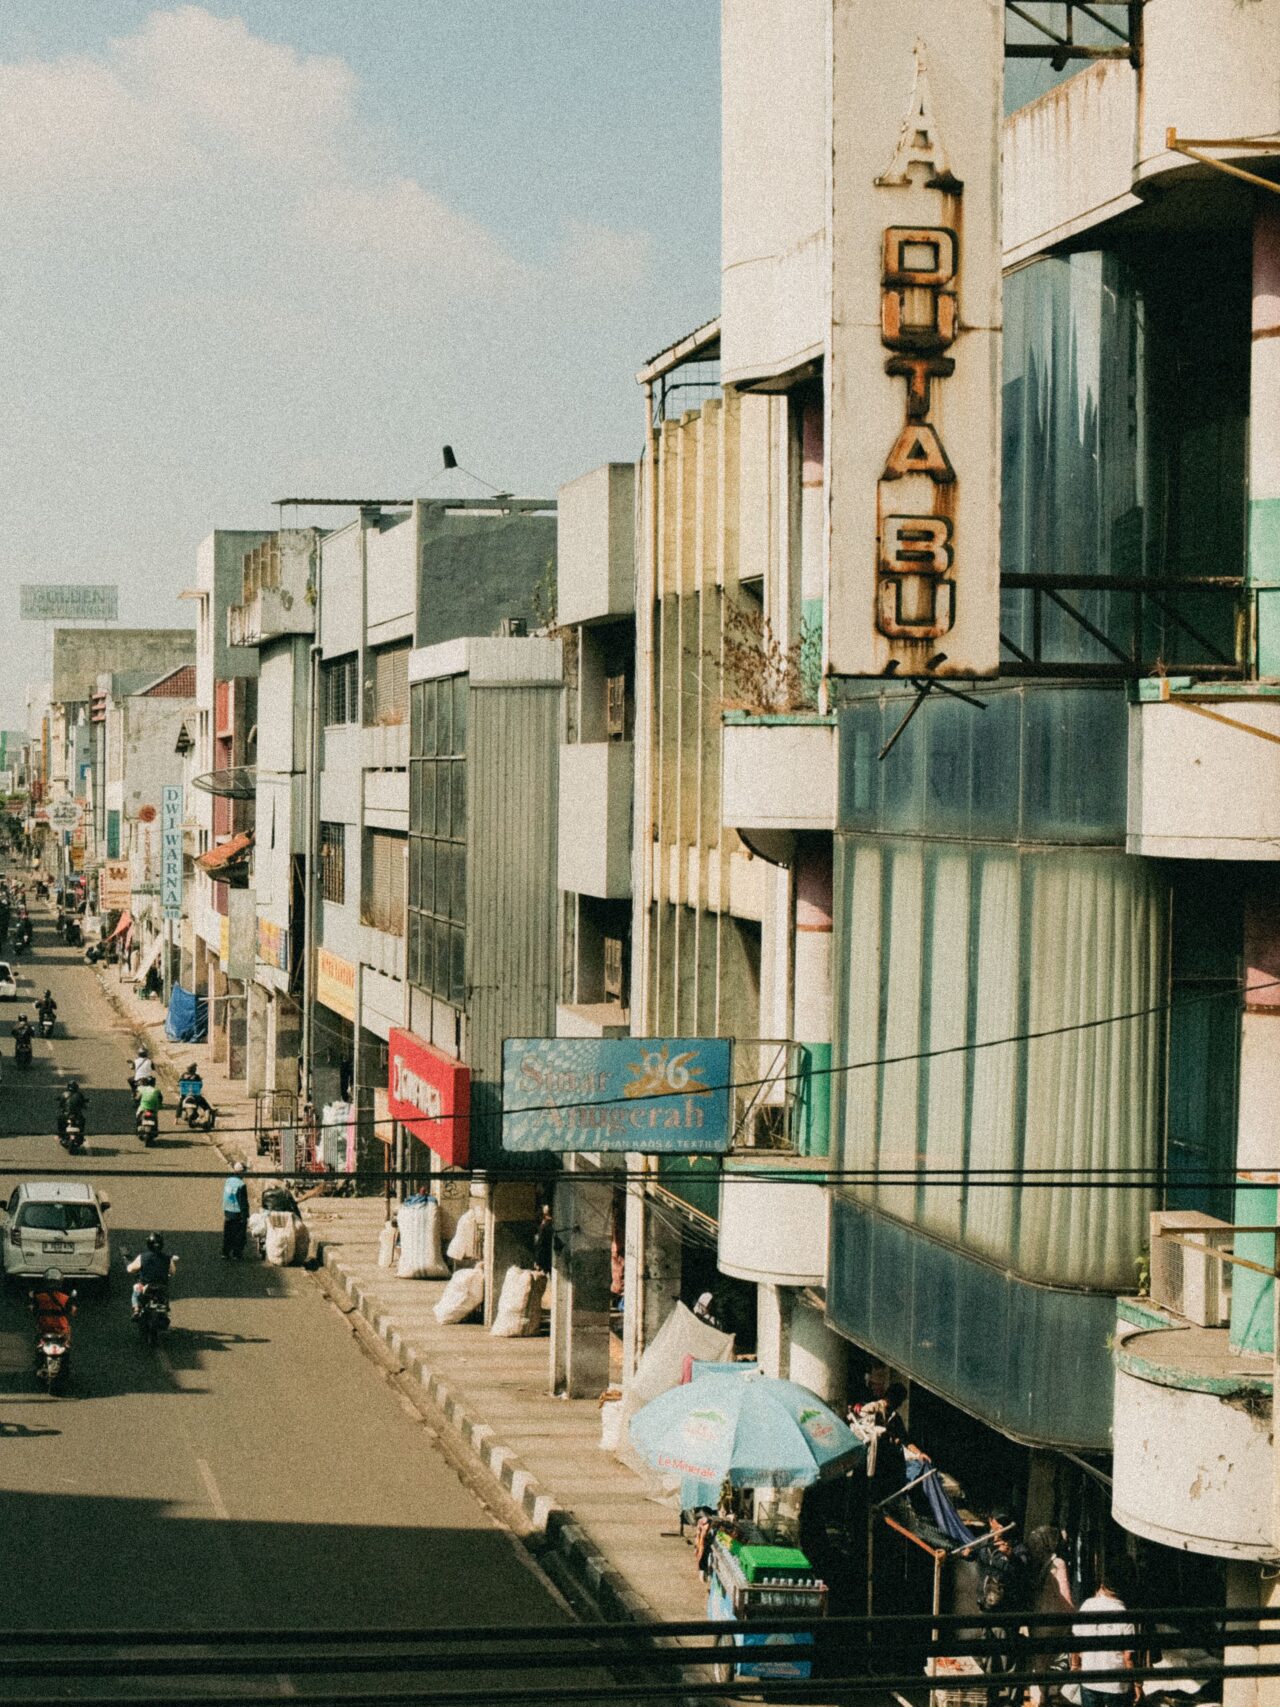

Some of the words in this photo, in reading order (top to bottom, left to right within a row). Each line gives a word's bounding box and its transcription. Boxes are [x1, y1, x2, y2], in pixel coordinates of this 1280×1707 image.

[165, 789, 180, 829] DWI
[165, 834, 180, 902] WARNA
[519, 1053, 612, 1093] Sinar
[641, 1052, 691, 1090] 96
[535, 1096, 704, 1133] Anugerah
[677, 1140, 721, 1149] TEXTILE
[657, 1454, 671, 1466] Le
[671, 1458, 717, 1479] Minerale
